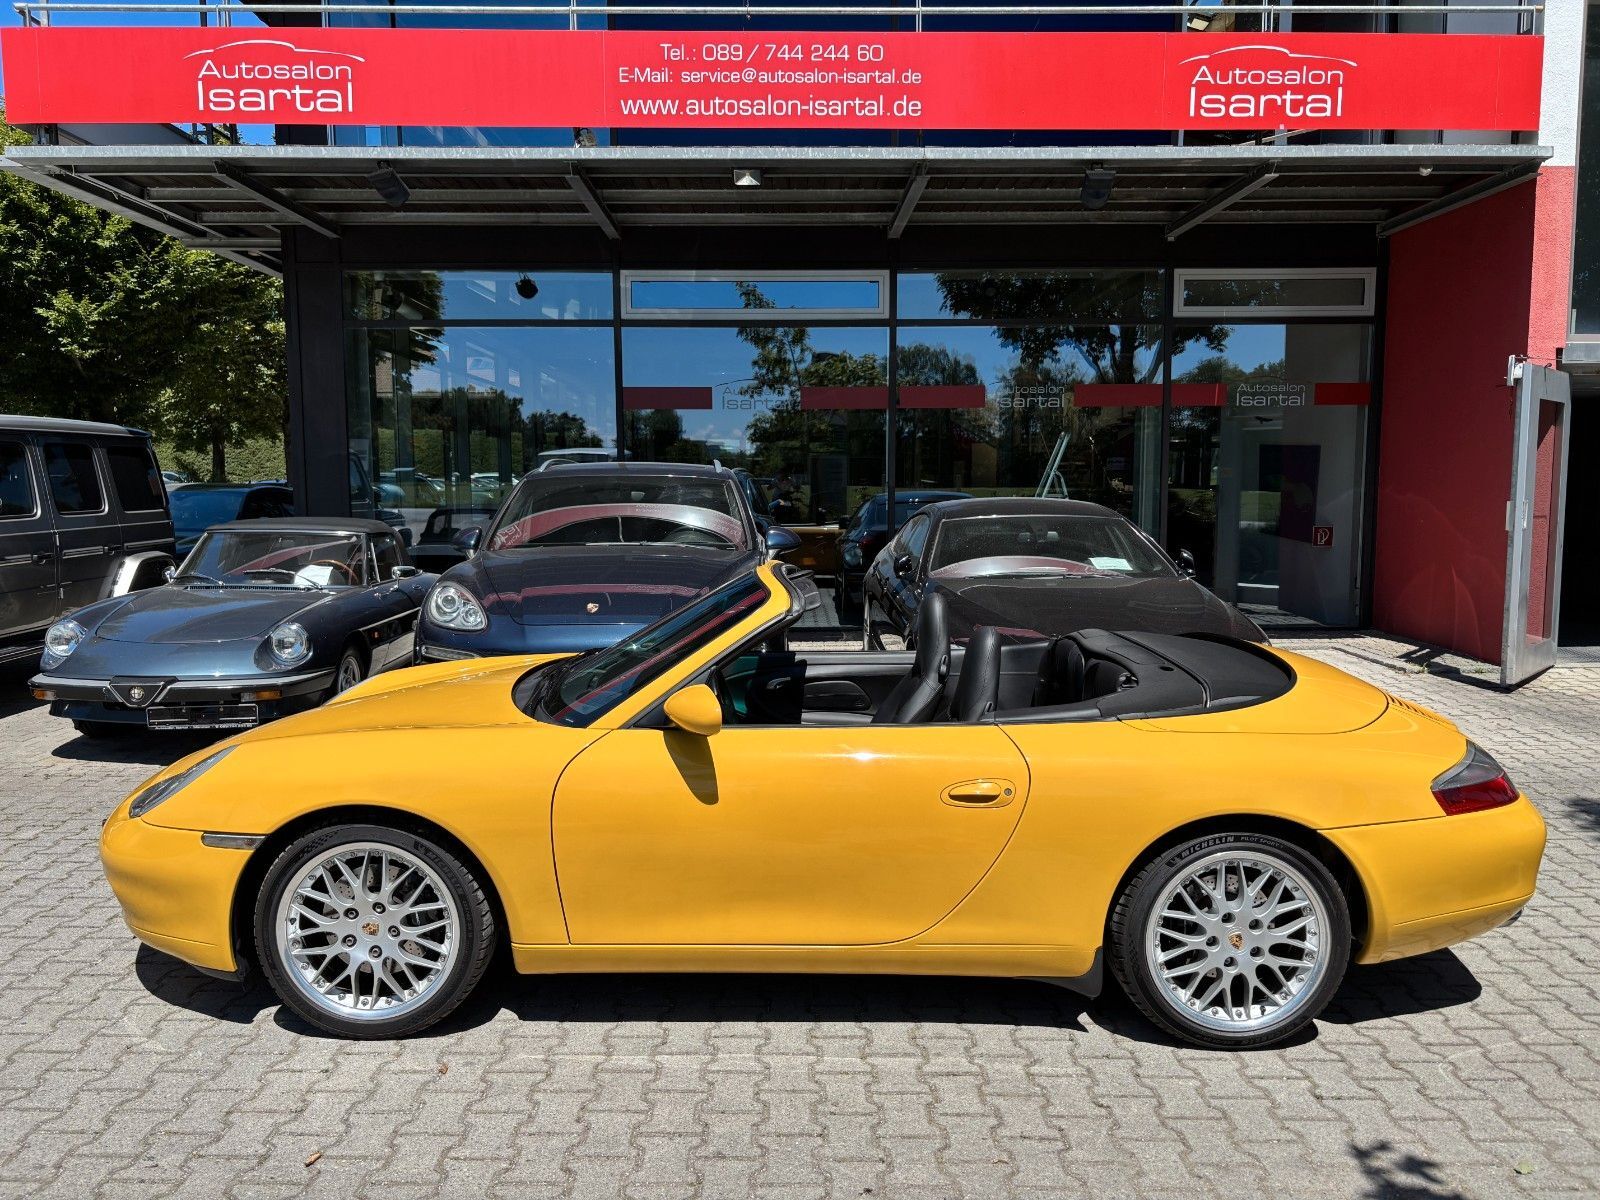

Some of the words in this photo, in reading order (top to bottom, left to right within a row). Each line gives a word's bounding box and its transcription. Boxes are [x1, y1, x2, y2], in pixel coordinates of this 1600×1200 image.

[659, 44, 696, 62] Tel.:
[702, 44, 743, 62] 089
[746, 44, 760, 63] /
[764, 44, 804, 62] 744
[810, 44, 850, 62] 244
[857, 44, 884, 62] 60
[197, 60, 351, 80] Autosalon
[618, 67, 673, 84] E-Mail:
[681, 68, 922, 85] service@autosalon-isartal.de
[1191, 66, 1344, 85] Autosalon
[197, 81, 353, 113] Isartal
[620, 95, 922, 117] www.autosalon-isartal.de
[1189, 87, 1344, 118] Isartal
[1005, 385, 1065, 394] utosalon
[1237, 383, 1306, 392] Autosalon
[999, 394, 1065, 408] sartal
[1236, 392, 1305, 407] Isartal
[1181, 835, 1235, 858] MICHELIN
